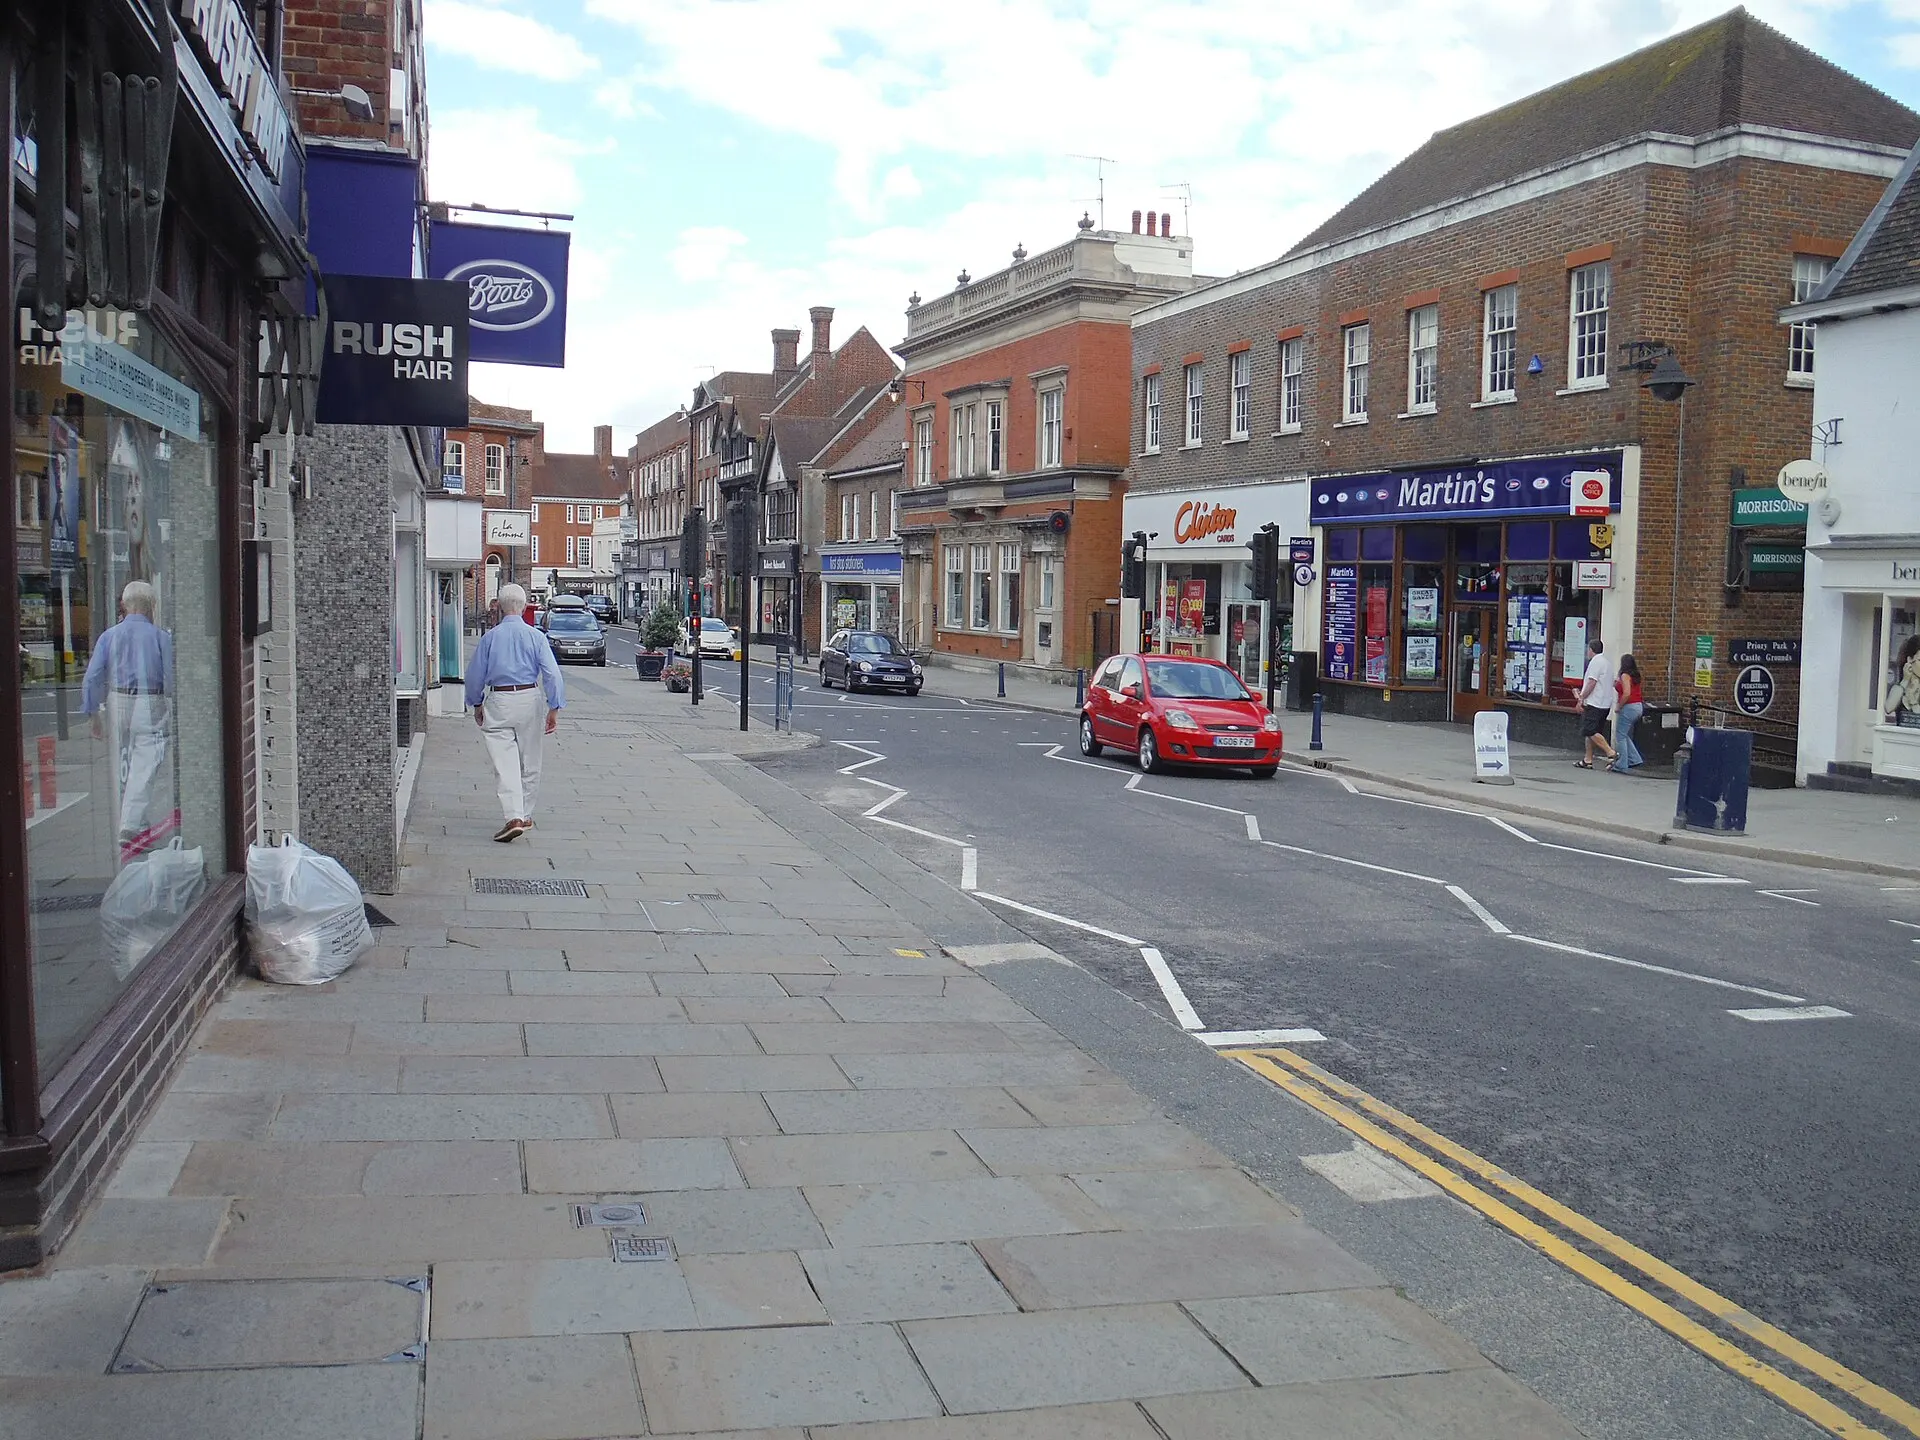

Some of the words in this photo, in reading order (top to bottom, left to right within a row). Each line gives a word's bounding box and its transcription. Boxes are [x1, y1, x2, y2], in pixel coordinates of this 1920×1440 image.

[469, 274, 533, 312] Boots
[333, 321, 453, 358] RUSH
[393, 359, 453, 380] HAIR
[1783, 472, 1827, 491] benefit
[1398, 470, 1495, 508] Martin's
[1737, 500, 1805, 514] MORRISONS
[503, 519, 513, 530] La
[1174, 500, 1237, 544] Clinton
[492, 527, 524, 538] Femme
[1217, 534, 1235, 543] CARDS
[1752, 554, 1802, 564] MORRISONS
[1330, 567, 1354, 577] Martin's
[1746, 641, 1767, 651] Priory
[1773, 641, 1788, 650] Park
[1740, 653, 1761, 661] Castle
[1766, 653, 1792, 661] Grounds
